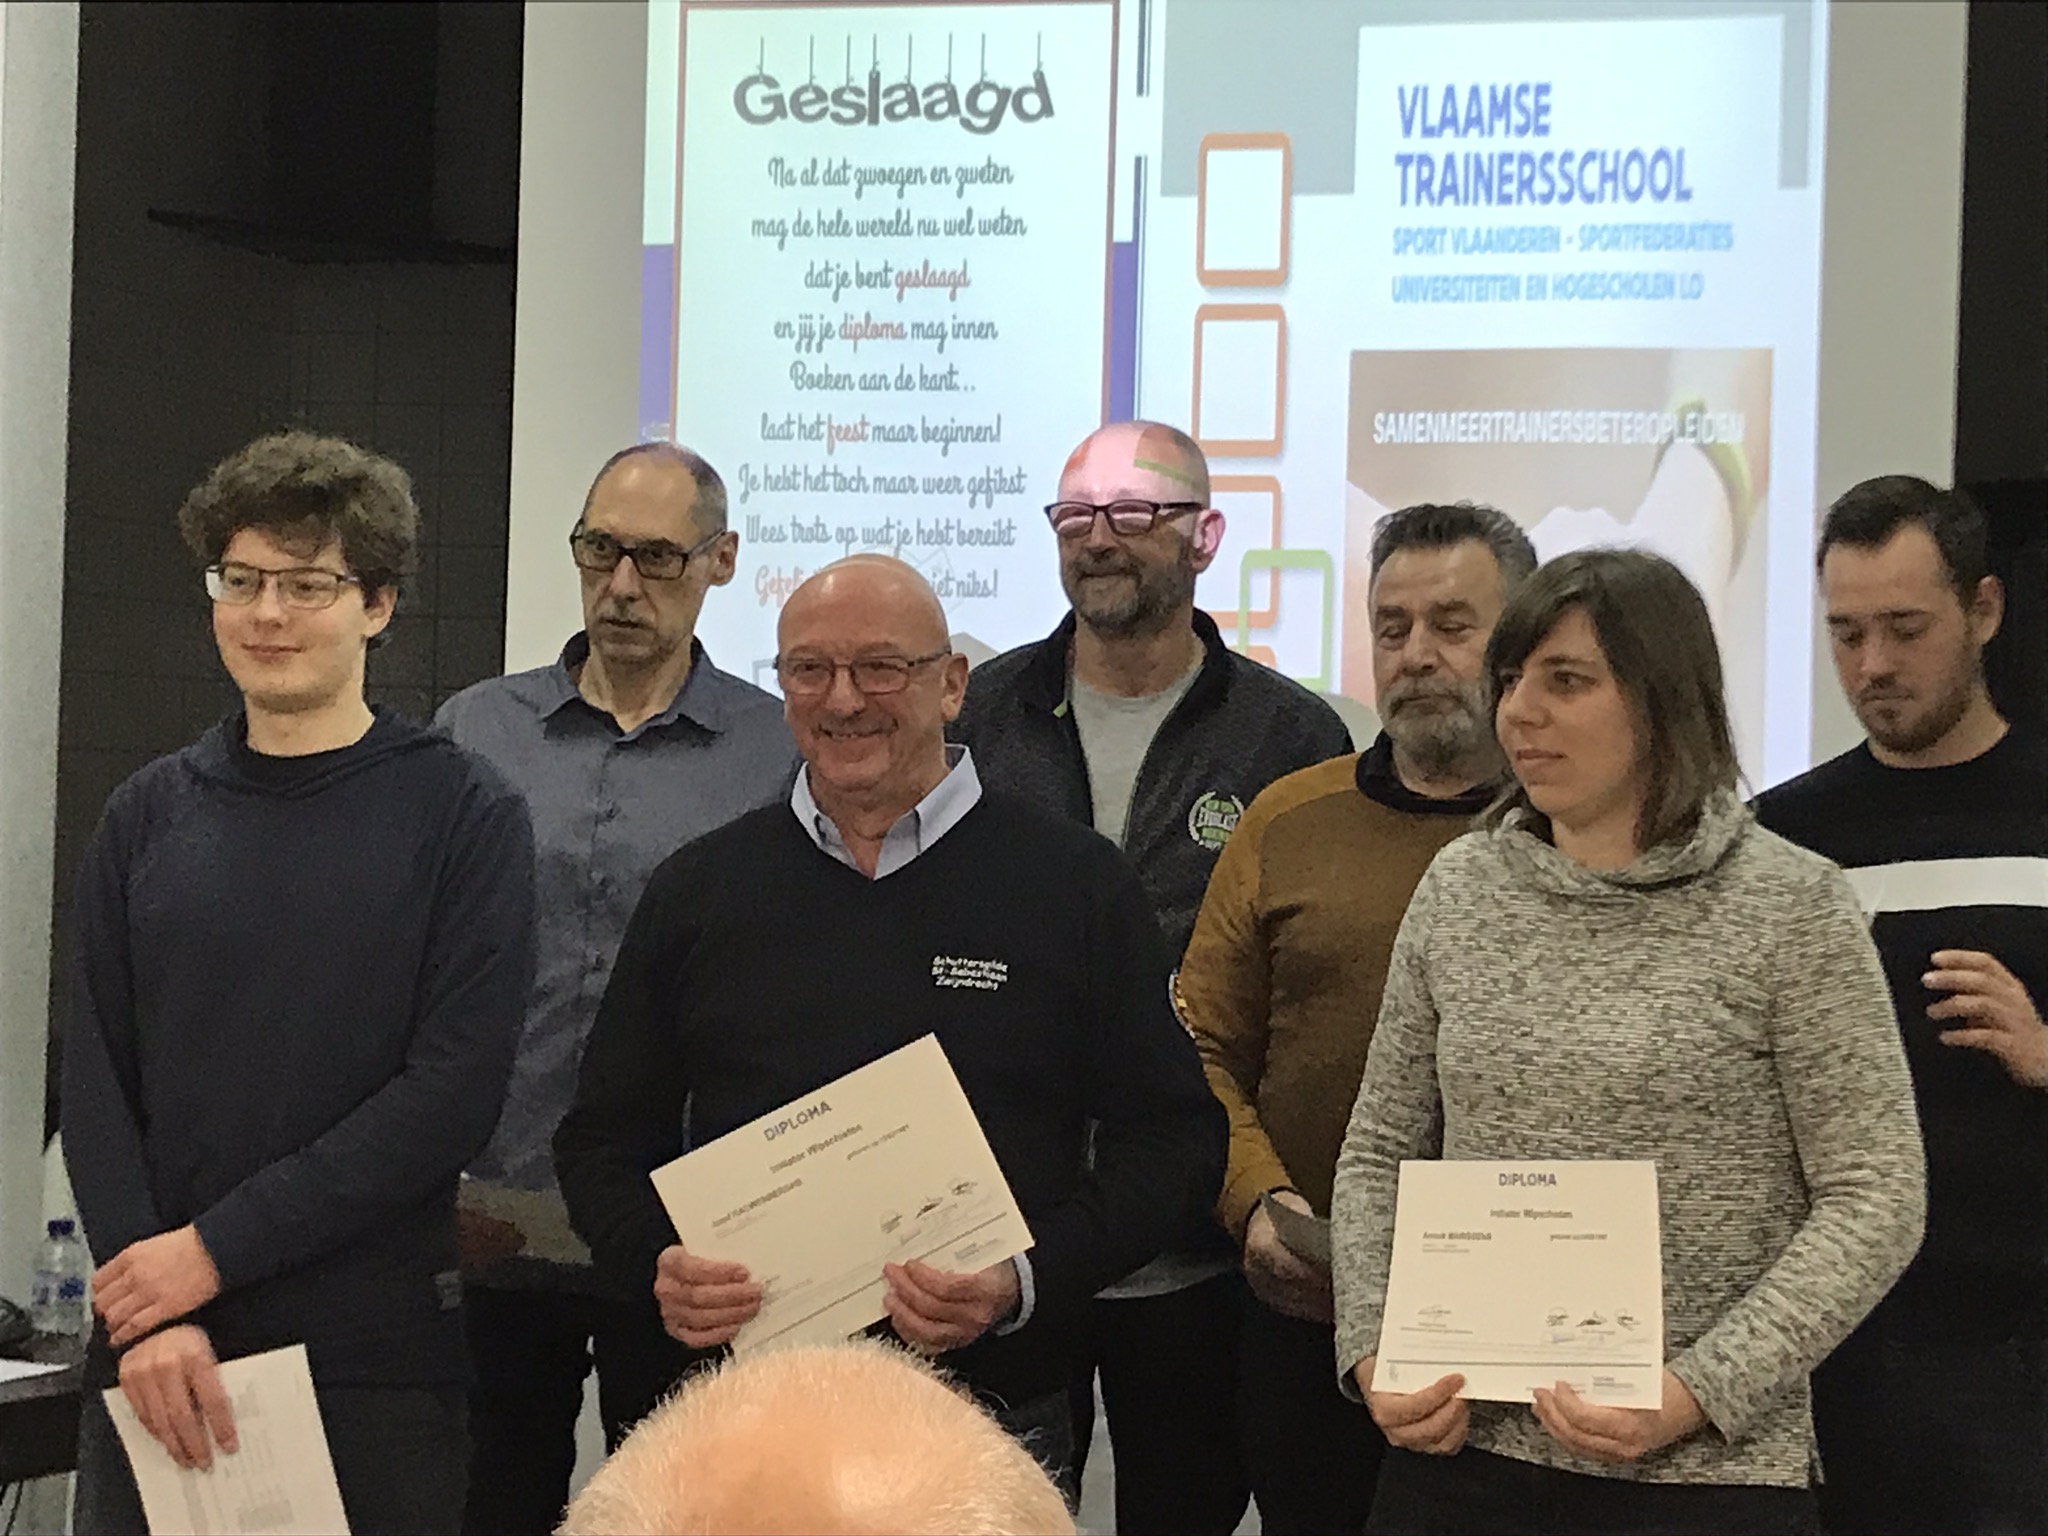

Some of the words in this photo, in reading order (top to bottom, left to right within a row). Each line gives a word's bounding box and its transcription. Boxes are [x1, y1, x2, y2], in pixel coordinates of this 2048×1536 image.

[733, 69, 1055, 135] Geslaagd
[1397, 82, 1552, 138] VLAAMSE
[768, 157, 797, 188] Na
[800, 157, 818, 185] al
[822, 157, 851, 185] dat
[854, 165, 927, 200] zwoegen
[930, 166, 951, 185] en
[955, 155, 1014, 199] zweten
[1394, 147, 1693, 206] TRAINERSSCHOOL
[752, 218, 789, 251] mag
[792, 209, 813, 237] de
[817, 208, 852, 237] hele
[856, 208, 913, 237] wereld
[917, 218, 940, 237] nu
[943, 206, 974, 236] wel
[978, 206, 1027, 236] weten
[1393, 226, 1447, 256] SPORT
[1450, 225, 1560, 255] VLAANDEREN
[804, 260, 834, 288] dat
[832, 263, 851, 302] je
[855, 259, 893, 288] bent
[895, 258, 971, 302] geslaagd
[1392, 274, 1520, 303] UNIVERSITEITEN
[1526, 274, 1548, 301] EN
[774, 321, 795, 339] en
[795, 313, 816, 353] jij
[816, 313, 835, 353] je
[839, 312, 907, 353] diploma
[911, 321, 947, 354] mag
[951, 313, 998, 340] innen
[790, 360, 854, 391] Boeken
[858, 373, 891, 391] aan
[894, 364, 915, 391] de
[761, 412, 796, 441] laat
[798, 413, 826, 441] het
[827, 413, 870, 455] feest
[872, 423, 917, 443] maar
[921, 413, 1001, 457] beginnen!
[739, 463, 760, 503] Je
[763, 464, 801, 492] hebt
[803, 464, 832, 492] het
[831, 465, 870, 494] toch
[873, 475, 919, 495] maar
[923, 475, 964, 495] weer
[967, 465, 1027, 509] gefikst
[746, 514, 788, 544] Wees
[790, 515, 832, 544] trots
[835, 525, 858, 557] op
[862, 516, 896, 546] wat
[893, 520, 913, 559] je
[916, 518, 956, 546] hebt
[956, 518, 1017, 547] bereikt
[929, 569, 955, 598] iet
[956, 568, 998, 598] niks!
[763, 1101, 832, 1141] DIPLOMA
[1498, 1173, 1557, 1187] DIPLOMA
